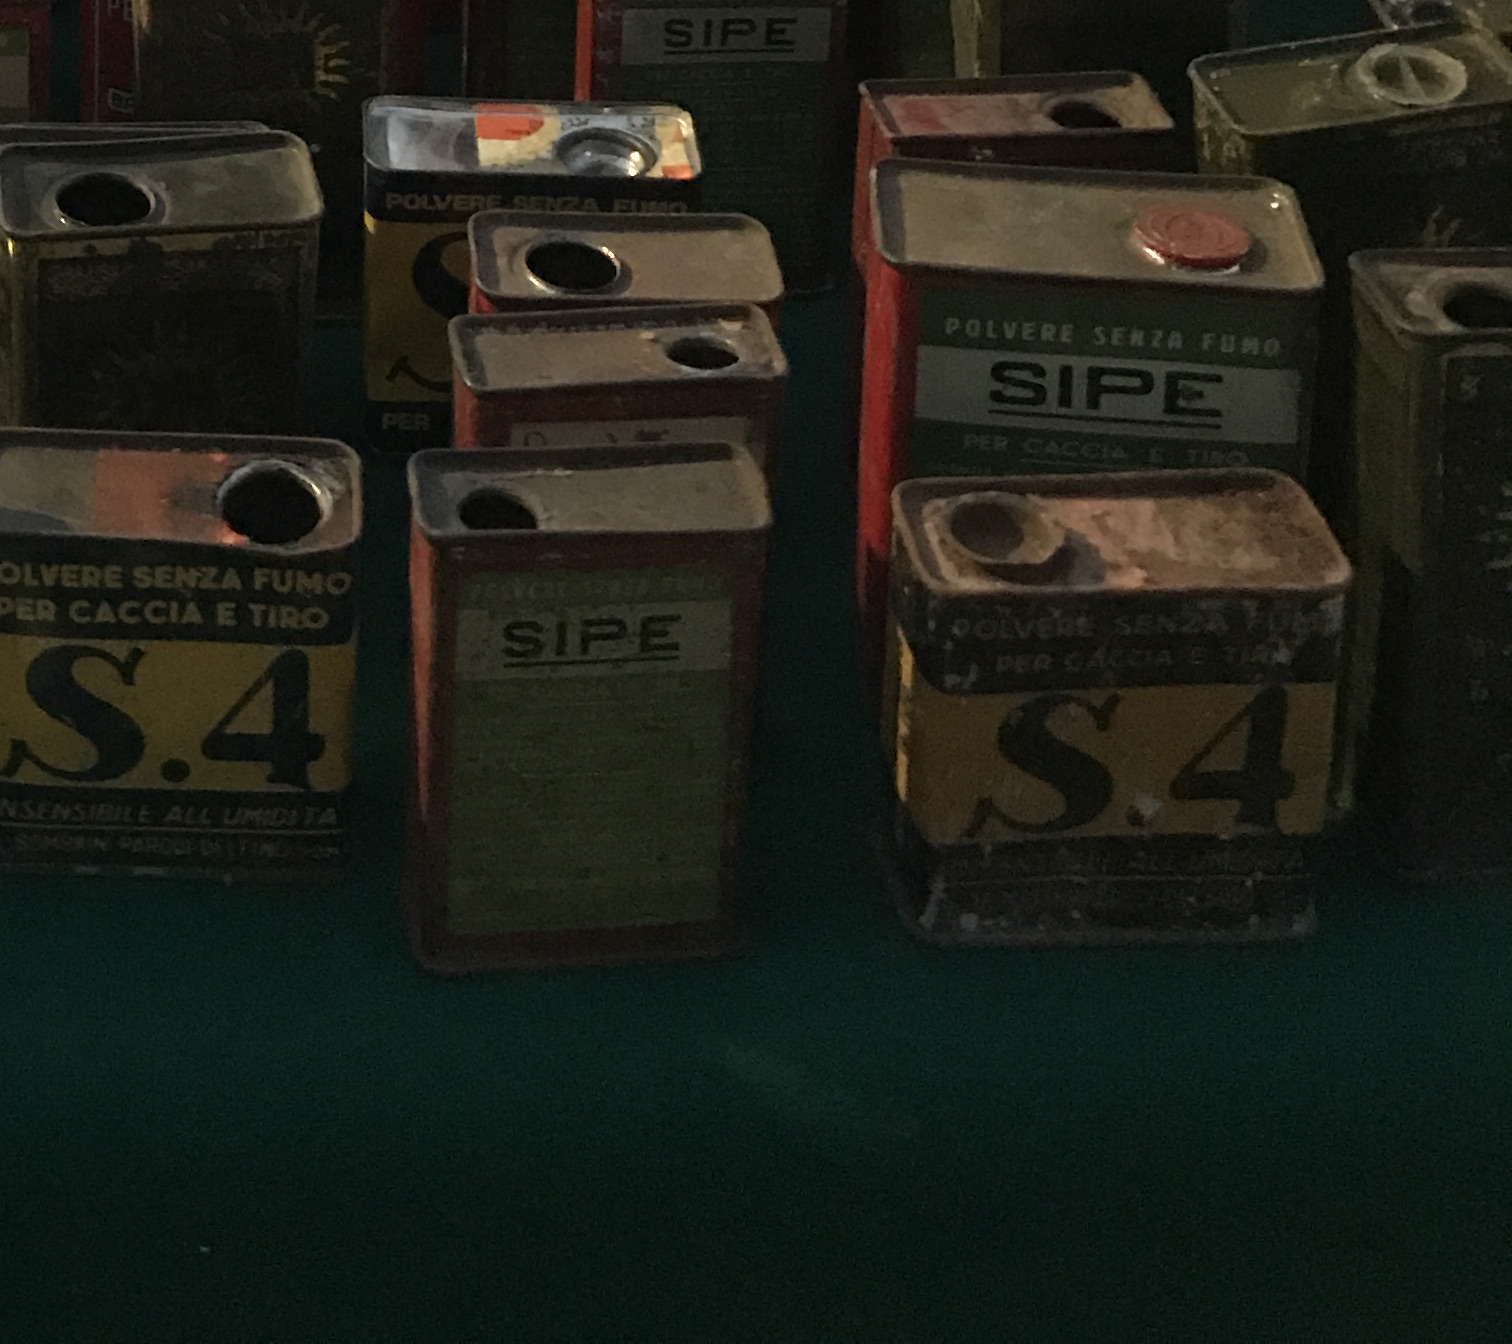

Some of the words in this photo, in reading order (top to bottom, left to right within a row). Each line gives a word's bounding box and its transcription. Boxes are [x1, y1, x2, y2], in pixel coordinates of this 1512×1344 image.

[664, 17, 797, 47] SIPE
[386, 192, 502, 212] POLVERE
[513, 194, 598, 213] SENZA
[944, 318, 1075, 344] POLVERE
[1094, 325, 1184, 349] SENZA
[1201, 331, 1282, 357] FUMO
[989, 360, 1223, 418] SIPE
[382, 413, 431, 430] PER
[964, 433, 1008, 452] PER
[1024, 436, 1129, 460] CACCIA
[132, 565, 242, 591] SENZA
[253, 568, 353, 595] FUMO
[68, 599, 203, 626] CACCIA
[217, 603, 238, 626] E
[248, 603, 330, 630] TIRO
[503, 614, 682, 658] SIPE
[0, 644, 325, 791] S.4
